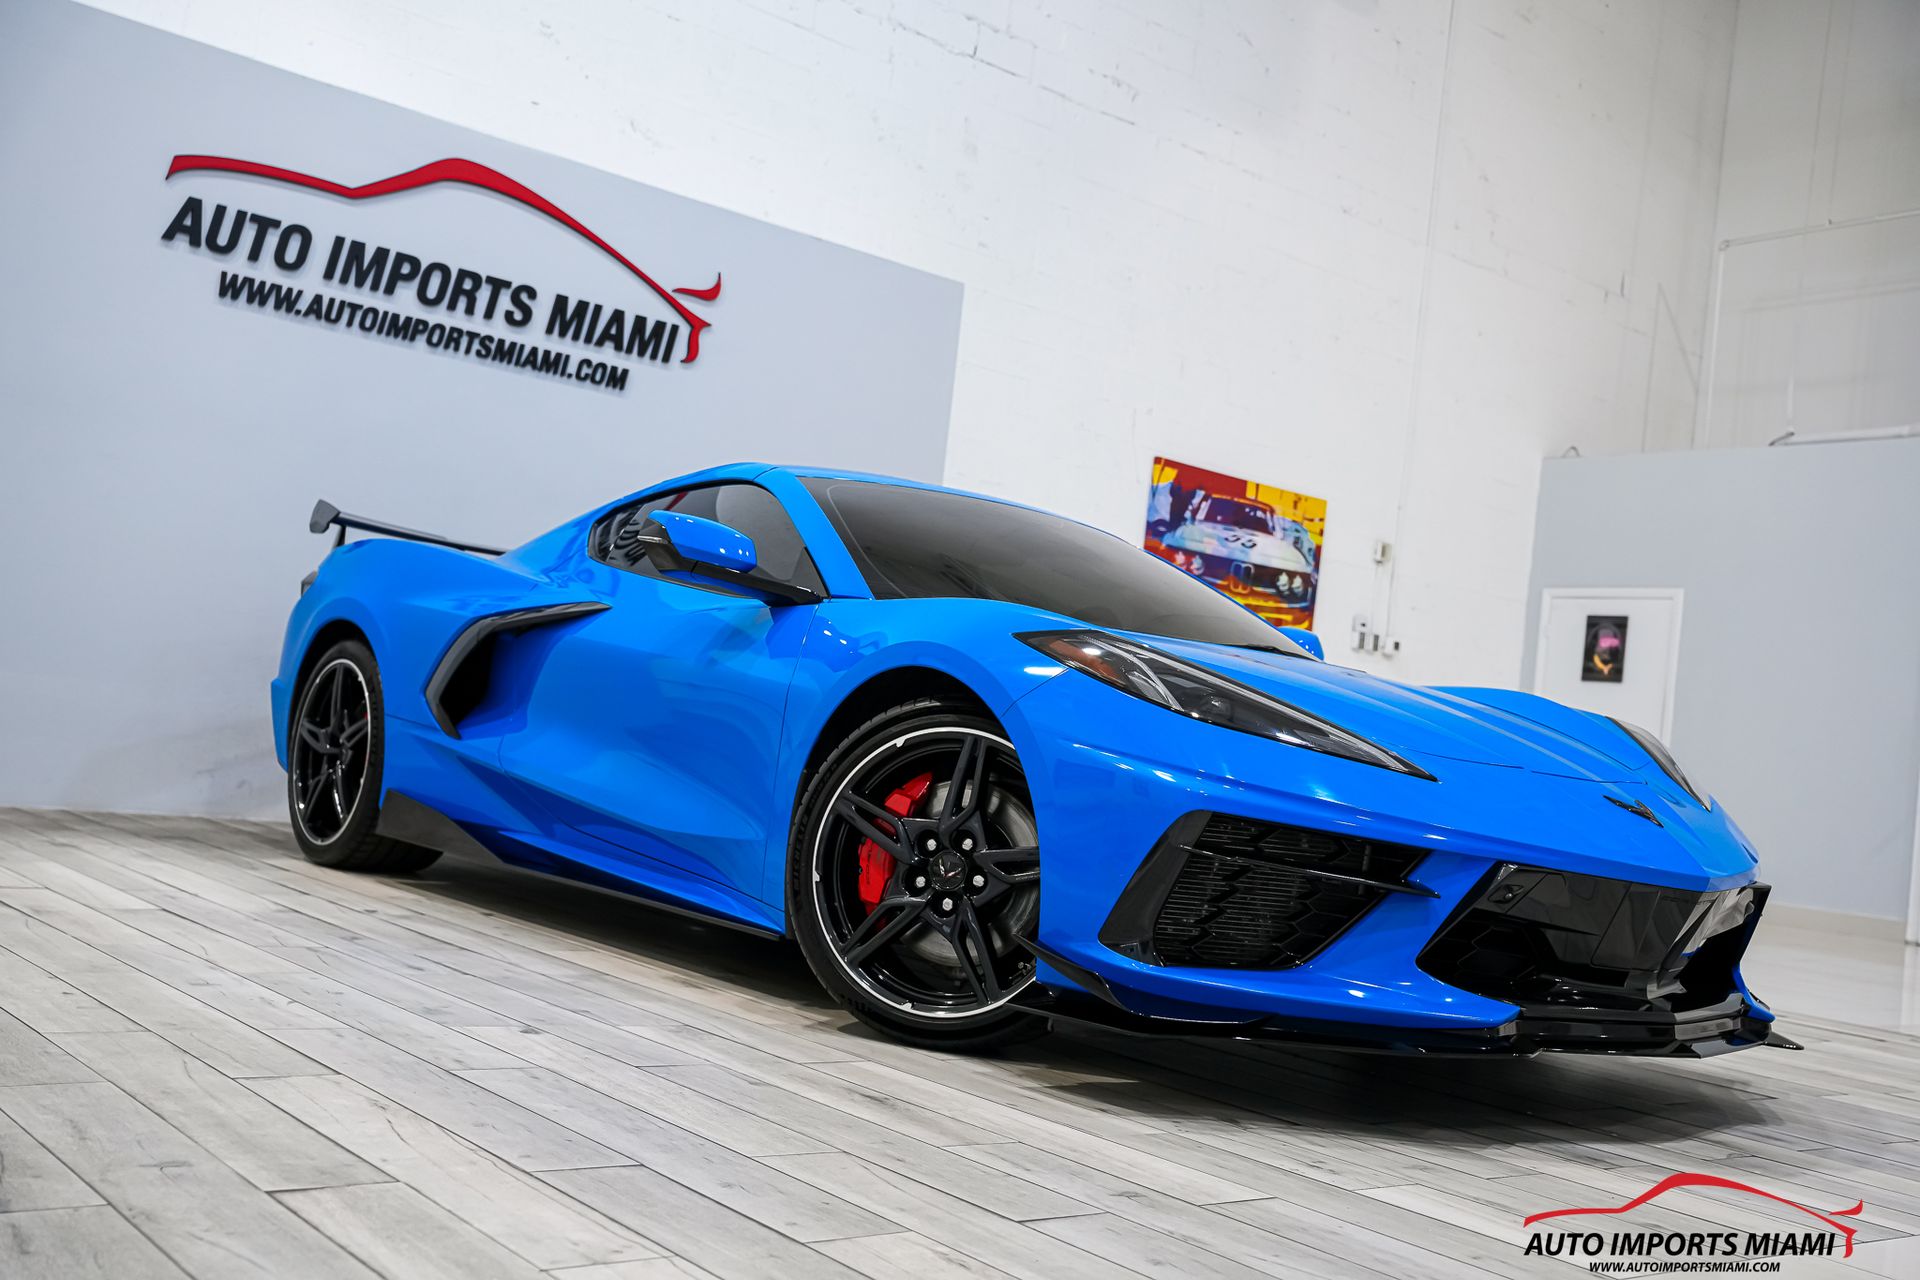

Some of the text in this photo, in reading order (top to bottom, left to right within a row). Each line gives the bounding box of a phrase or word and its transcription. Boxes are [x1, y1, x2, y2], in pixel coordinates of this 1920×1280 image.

[161, 196, 680, 364] AUTO IMPORTS MIAMI
[218, 270, 630, 392] WWW.AUTOIMPORTSMIAMI.COM
